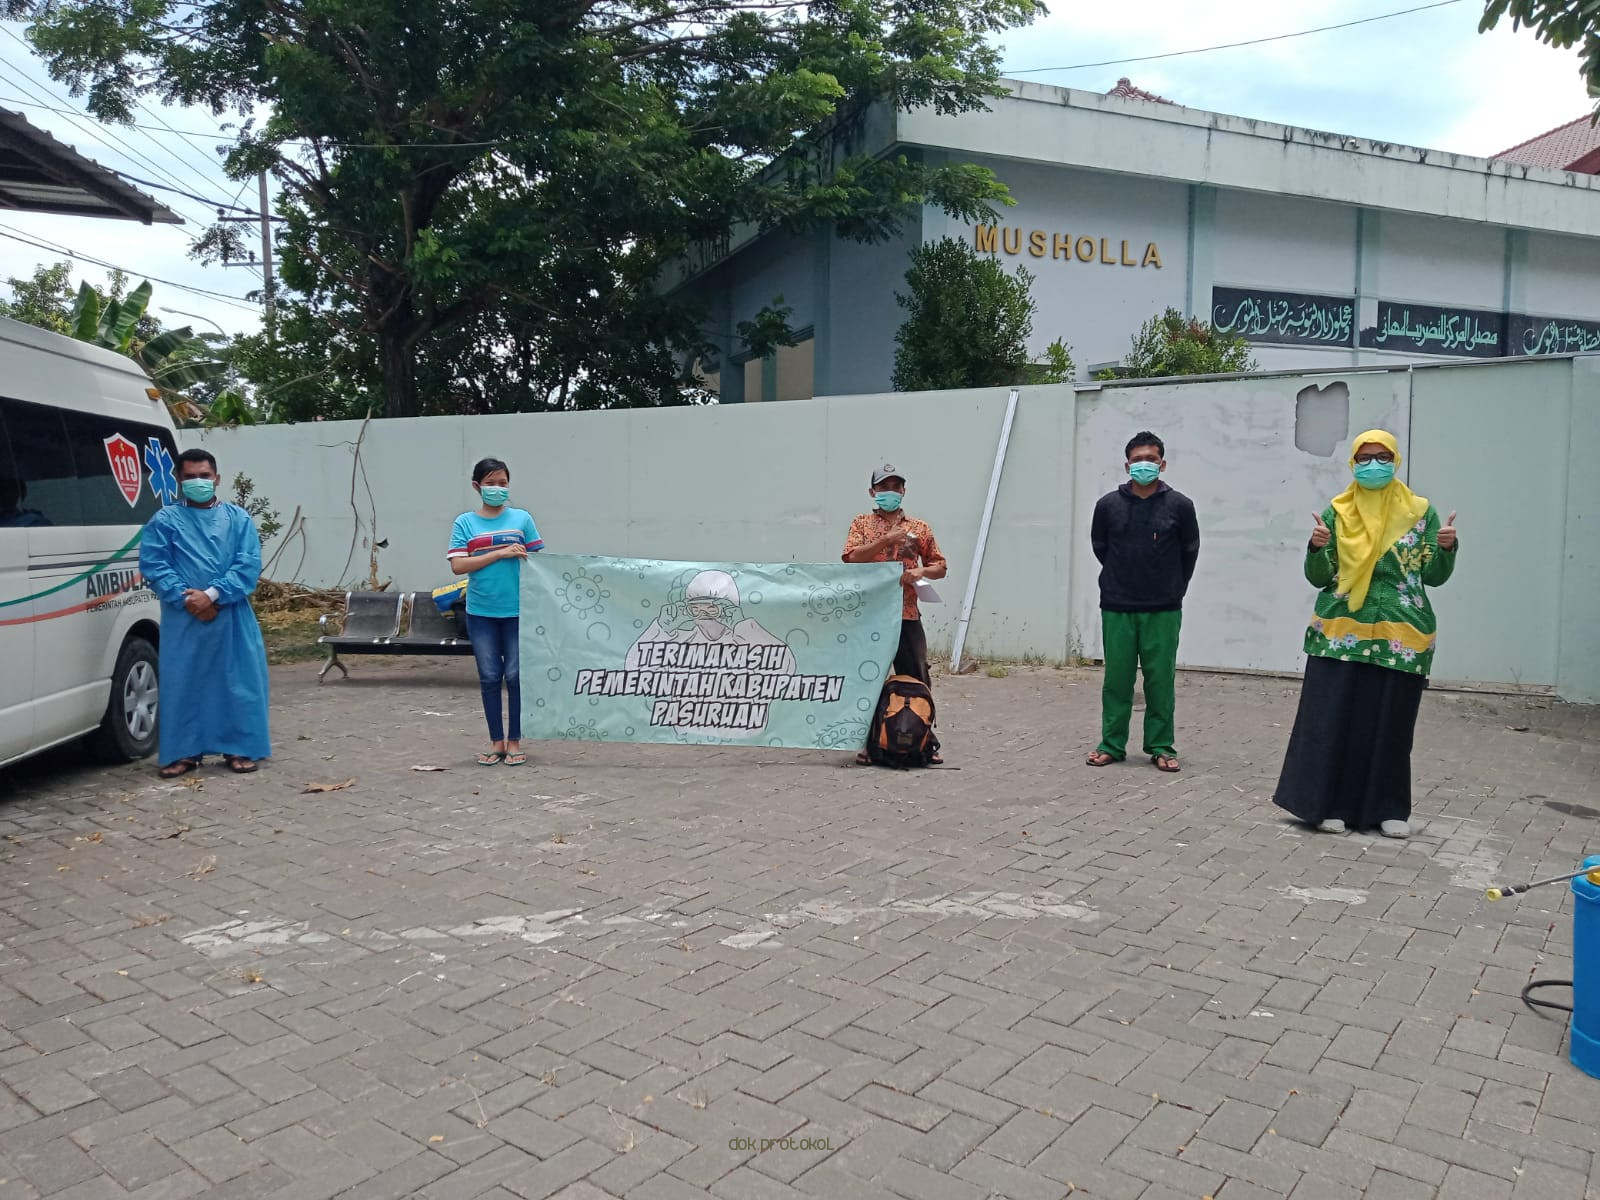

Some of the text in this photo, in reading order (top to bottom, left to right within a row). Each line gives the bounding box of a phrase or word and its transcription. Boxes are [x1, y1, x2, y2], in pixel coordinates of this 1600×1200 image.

[975, 224, 1162, 268] MUSHOLLA
[114, 454, 138, 482] 119
[637, 642, 786, 670] TERIMAKASIH
[574, 669, 844, 702] PEMERINTAH KABUPATEN
[649, 701, 767, 729] PASURUAN
